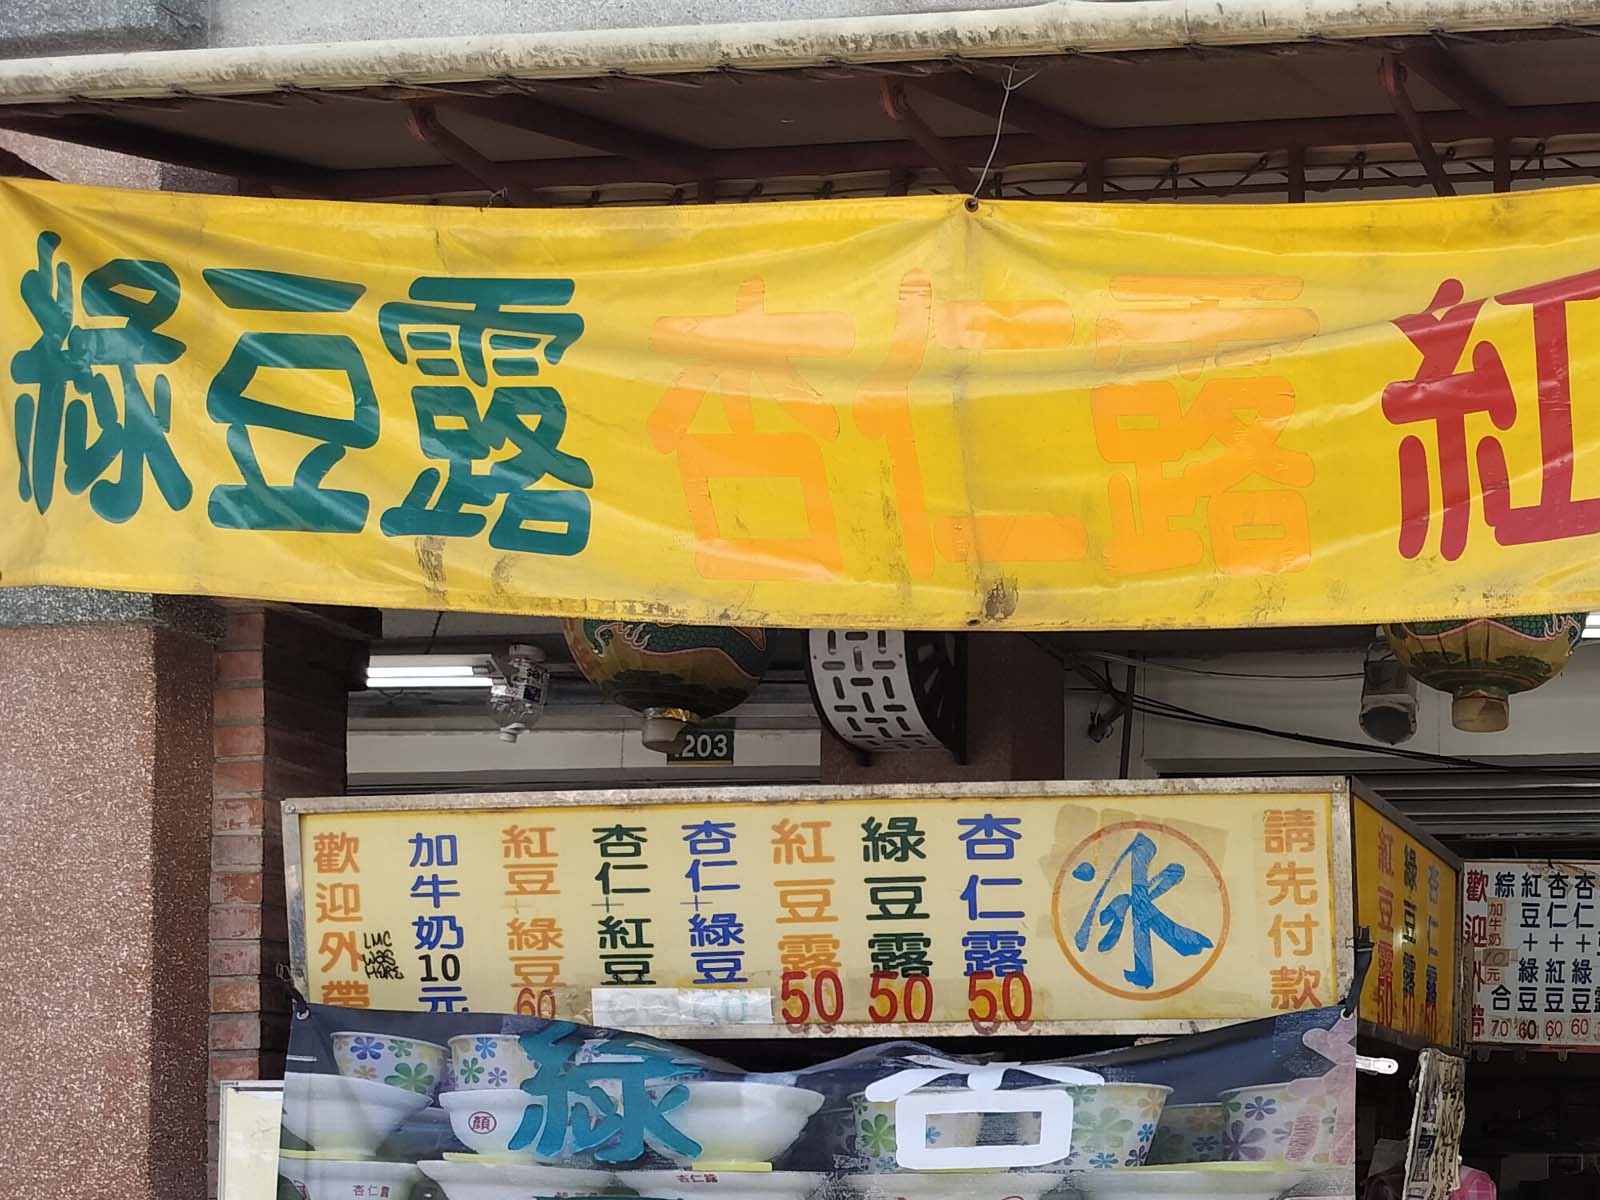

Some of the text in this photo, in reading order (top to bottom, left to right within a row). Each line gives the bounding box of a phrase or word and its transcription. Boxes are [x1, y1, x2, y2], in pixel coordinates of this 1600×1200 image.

[12, 230, 594, 556] 綠豆露
[645, 266, 1319, 581] 杏仁露
[312, 831, 370, 1009] 歡迎外帶
[408, 832, 469, 1013] 加牛奶10元
[770, 816, 842, 982] 紅豆露
[860, 815, 934, 977] 綠豆露
[956, 813, 1028, 977] 杏仁露
[1072, 831, 1214, 990] 冰
[1262, 807, 1323, 1011] 請先付款
[779, 968, 844, 1027] 50
[867, 970, 935, 1025] 50
[967, 969, 1034, 1027] 50
